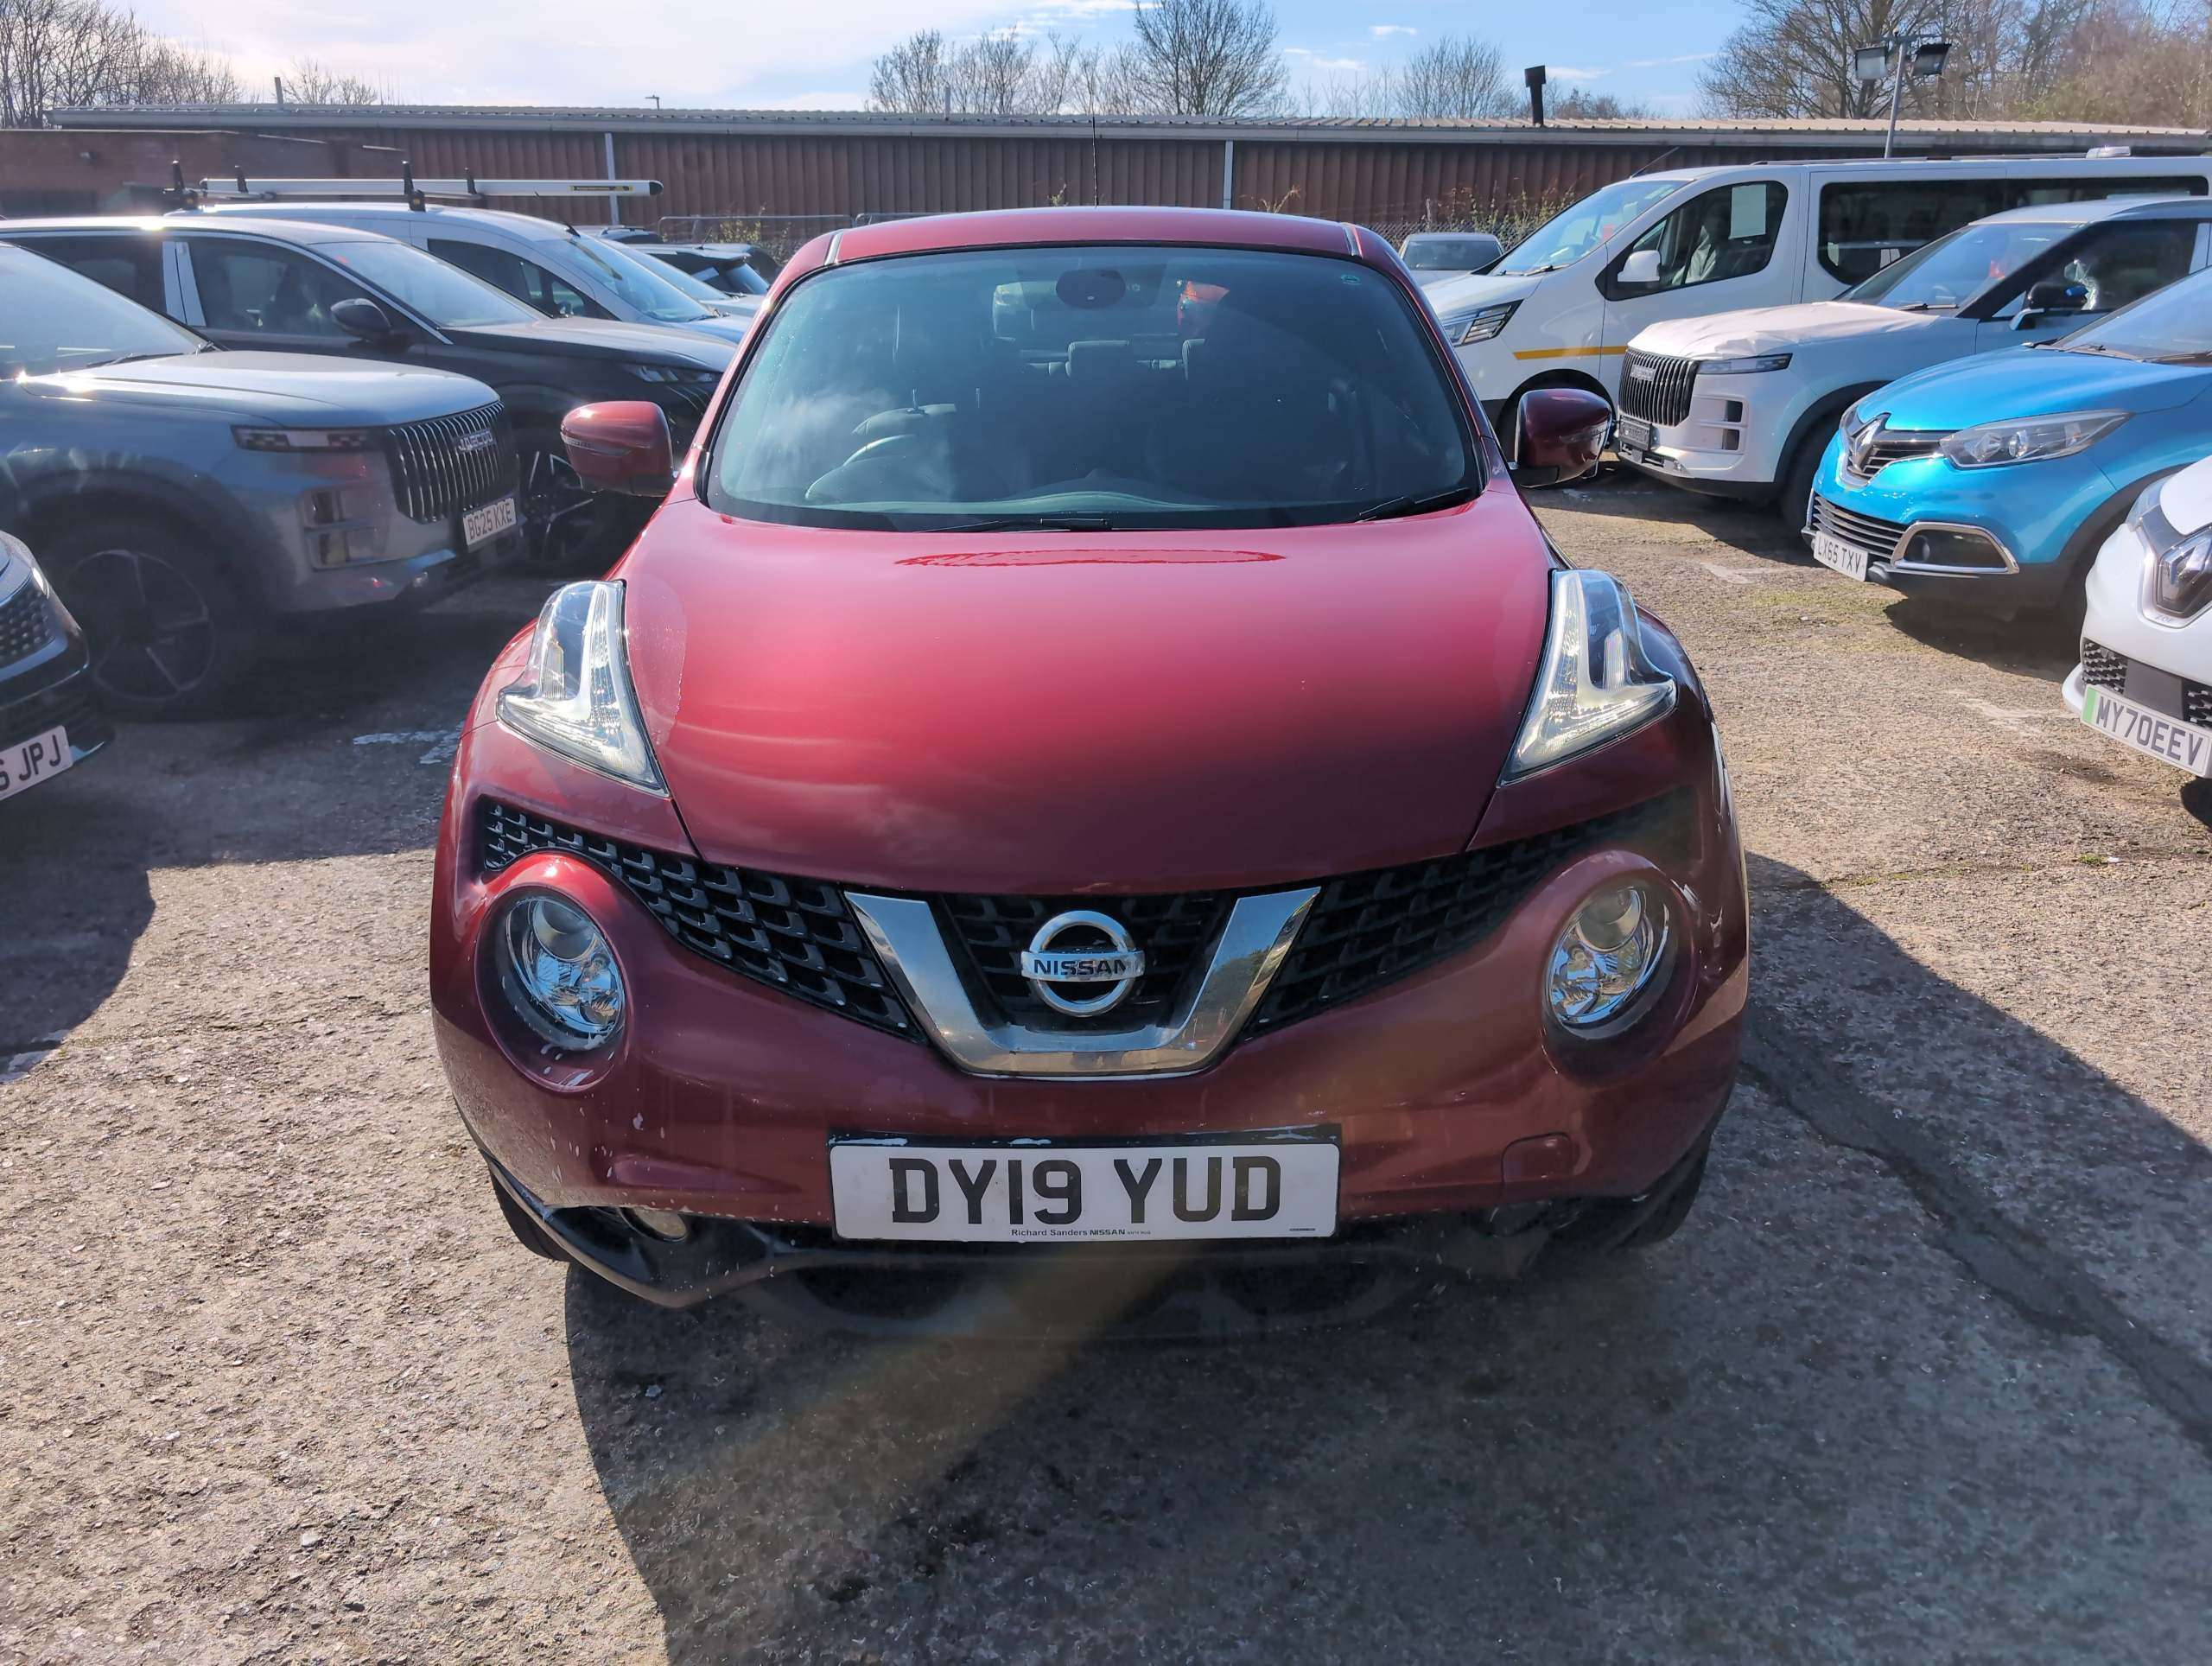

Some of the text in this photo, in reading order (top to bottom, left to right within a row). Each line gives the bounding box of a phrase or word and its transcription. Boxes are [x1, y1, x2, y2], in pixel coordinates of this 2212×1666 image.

[1818, 536, 1861, 574] LX65 TXV
[19, 734, 62, 781] JPJ
[1033, 959, 1128, 976] NISSAN
[888, 1155, 1281, 1225] DY19 YUD
